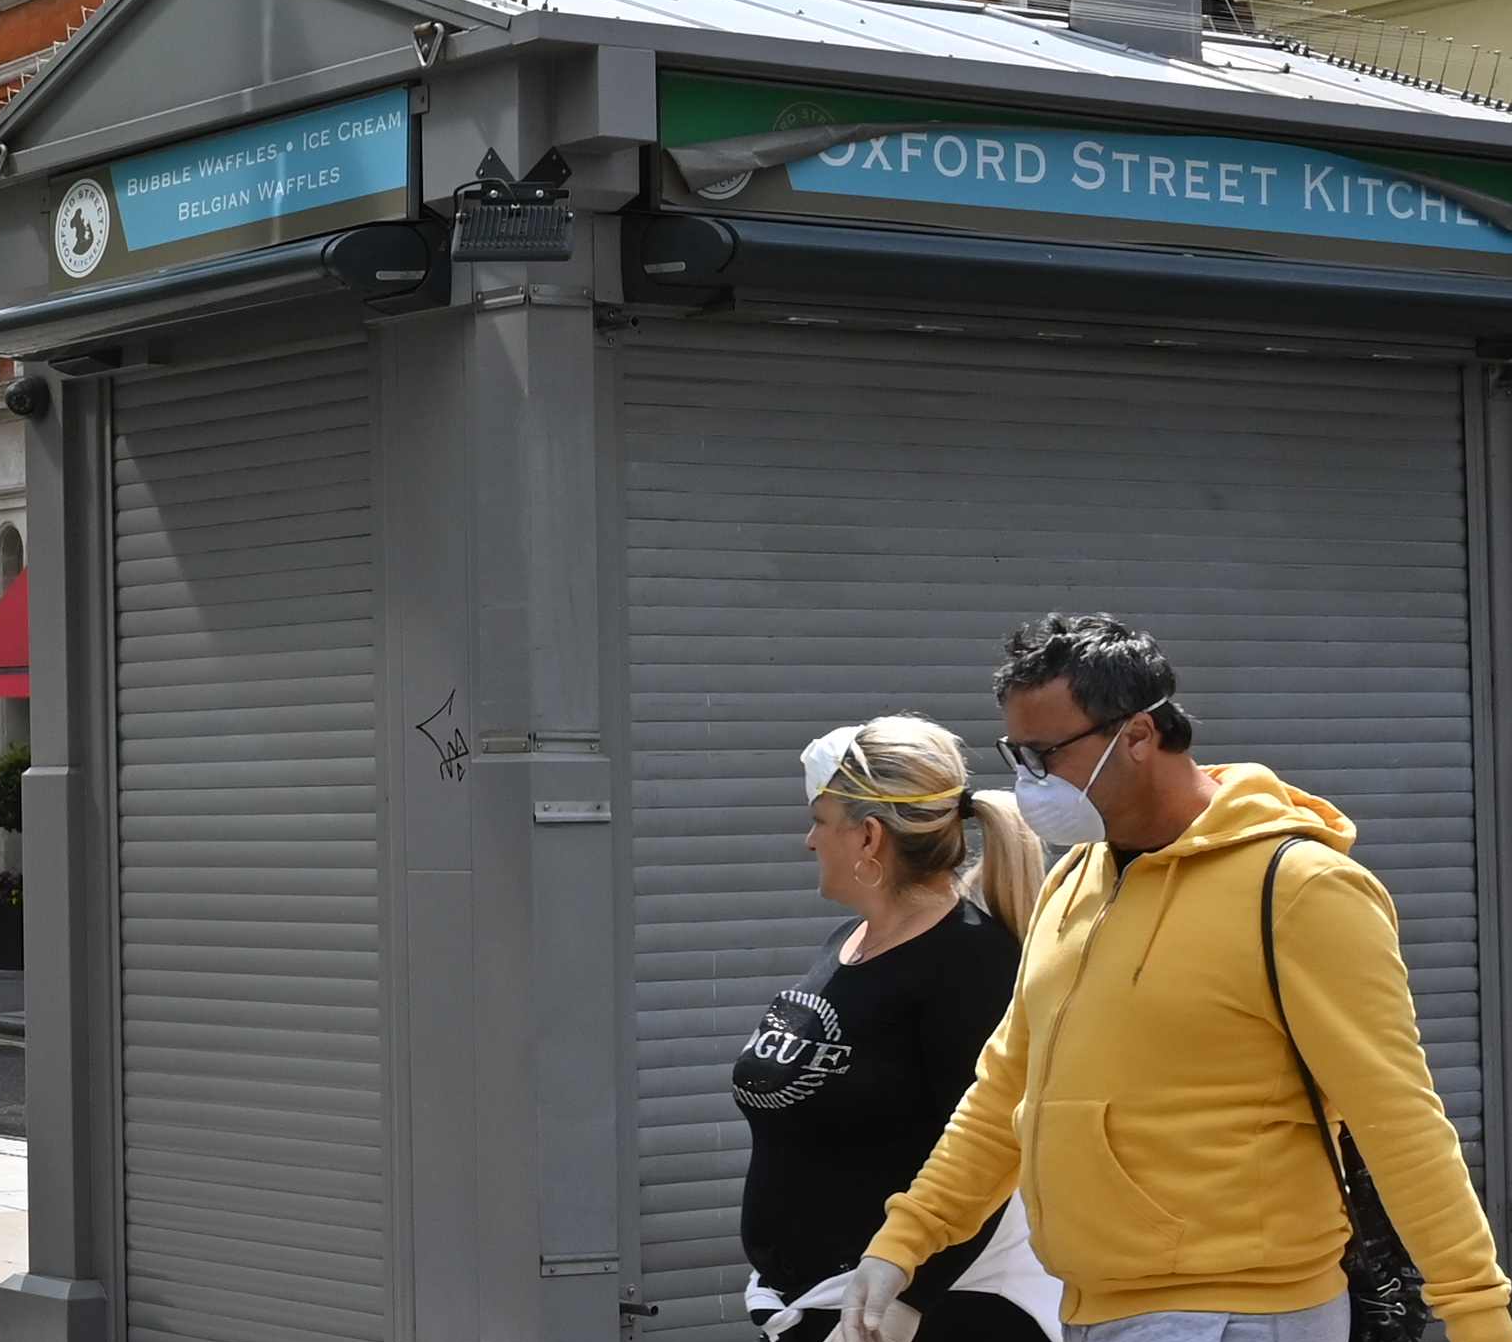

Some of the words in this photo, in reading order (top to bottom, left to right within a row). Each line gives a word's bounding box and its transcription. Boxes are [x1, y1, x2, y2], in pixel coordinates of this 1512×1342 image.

[127, 166, 192, 196] BUBBLE
[198, 143, 277, 177] WAFFLES
[303, 130, 330, 150] ICE
[337, 111, 402, 141] CREAM
[1071, 141, 1277, 205] STREET
[1304, 164, 1492, 227] KITCH
[178, 190, 250, 221] BELGIAN
[258, 166, 341, 200] WAFFLES
[742, 1028, 852, 1074] GUE
